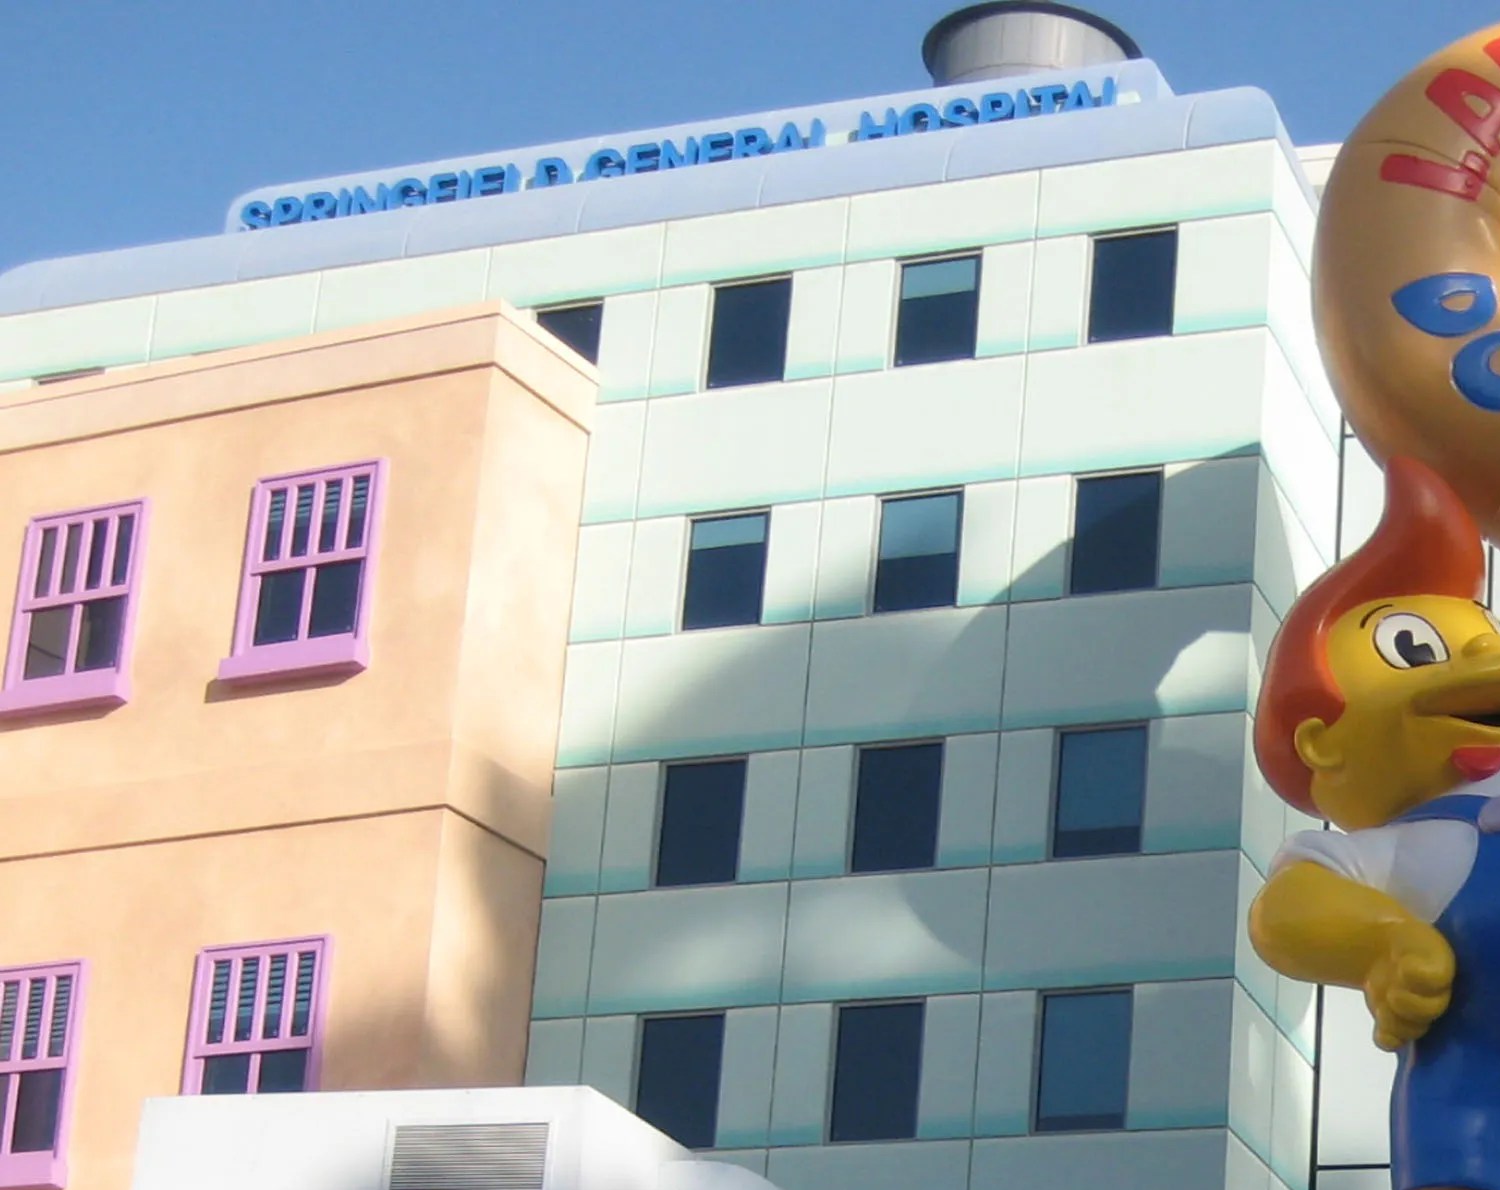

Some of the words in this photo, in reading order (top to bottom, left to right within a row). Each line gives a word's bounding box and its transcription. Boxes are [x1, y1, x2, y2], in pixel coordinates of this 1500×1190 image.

[240, 156, 574, 231] SPRINGFIELD
[580, 117, 826, 180] GENERAL
[856, 76, 1117, 141] HOSPITAL
